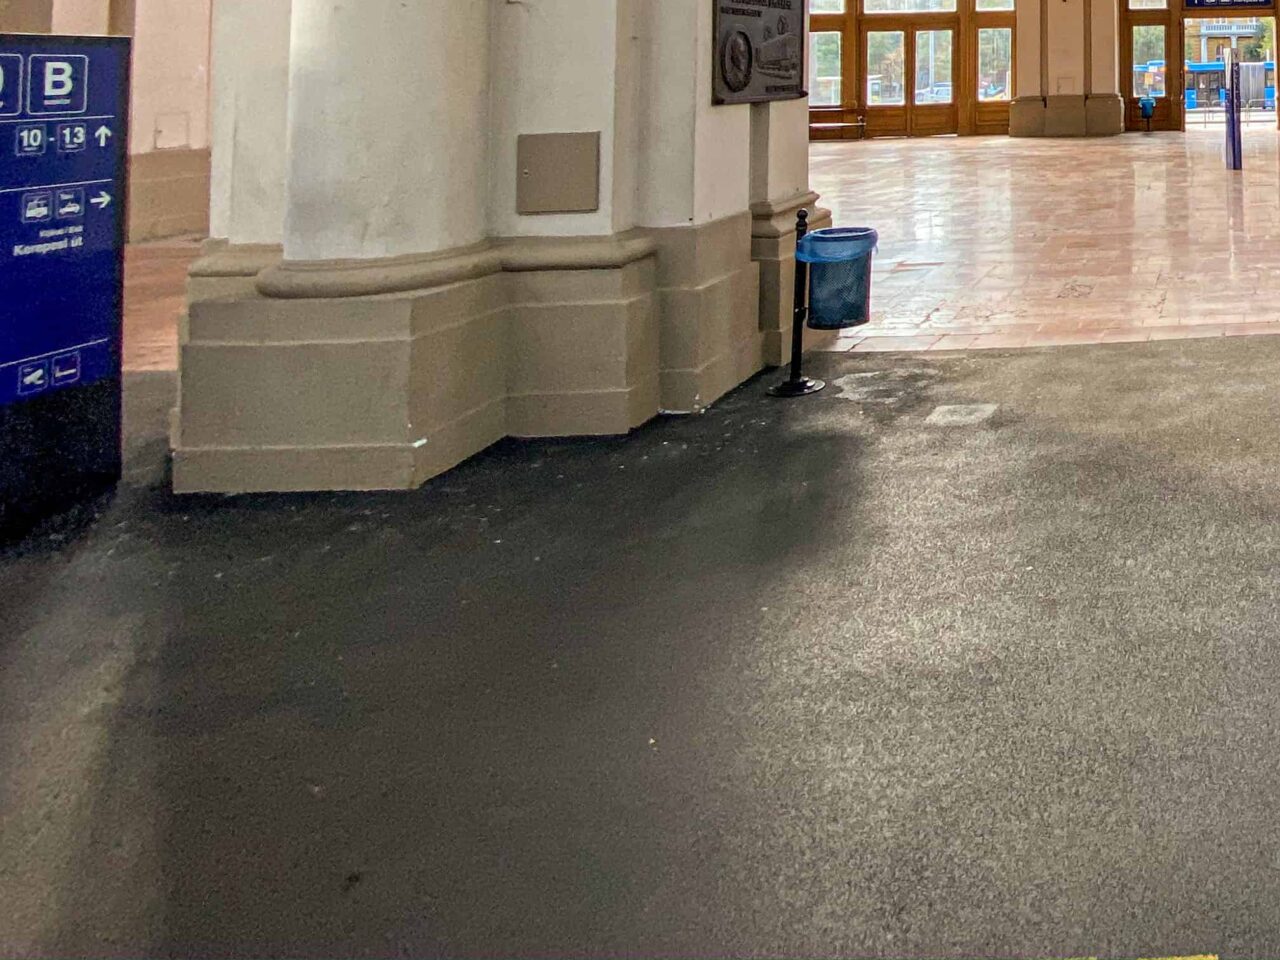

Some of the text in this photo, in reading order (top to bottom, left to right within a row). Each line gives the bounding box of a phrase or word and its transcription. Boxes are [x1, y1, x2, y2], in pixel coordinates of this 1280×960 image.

[44, 61, 73, 96] B
[19, 128, 42, 147] 10
[62, 127, 85, 144] 13
